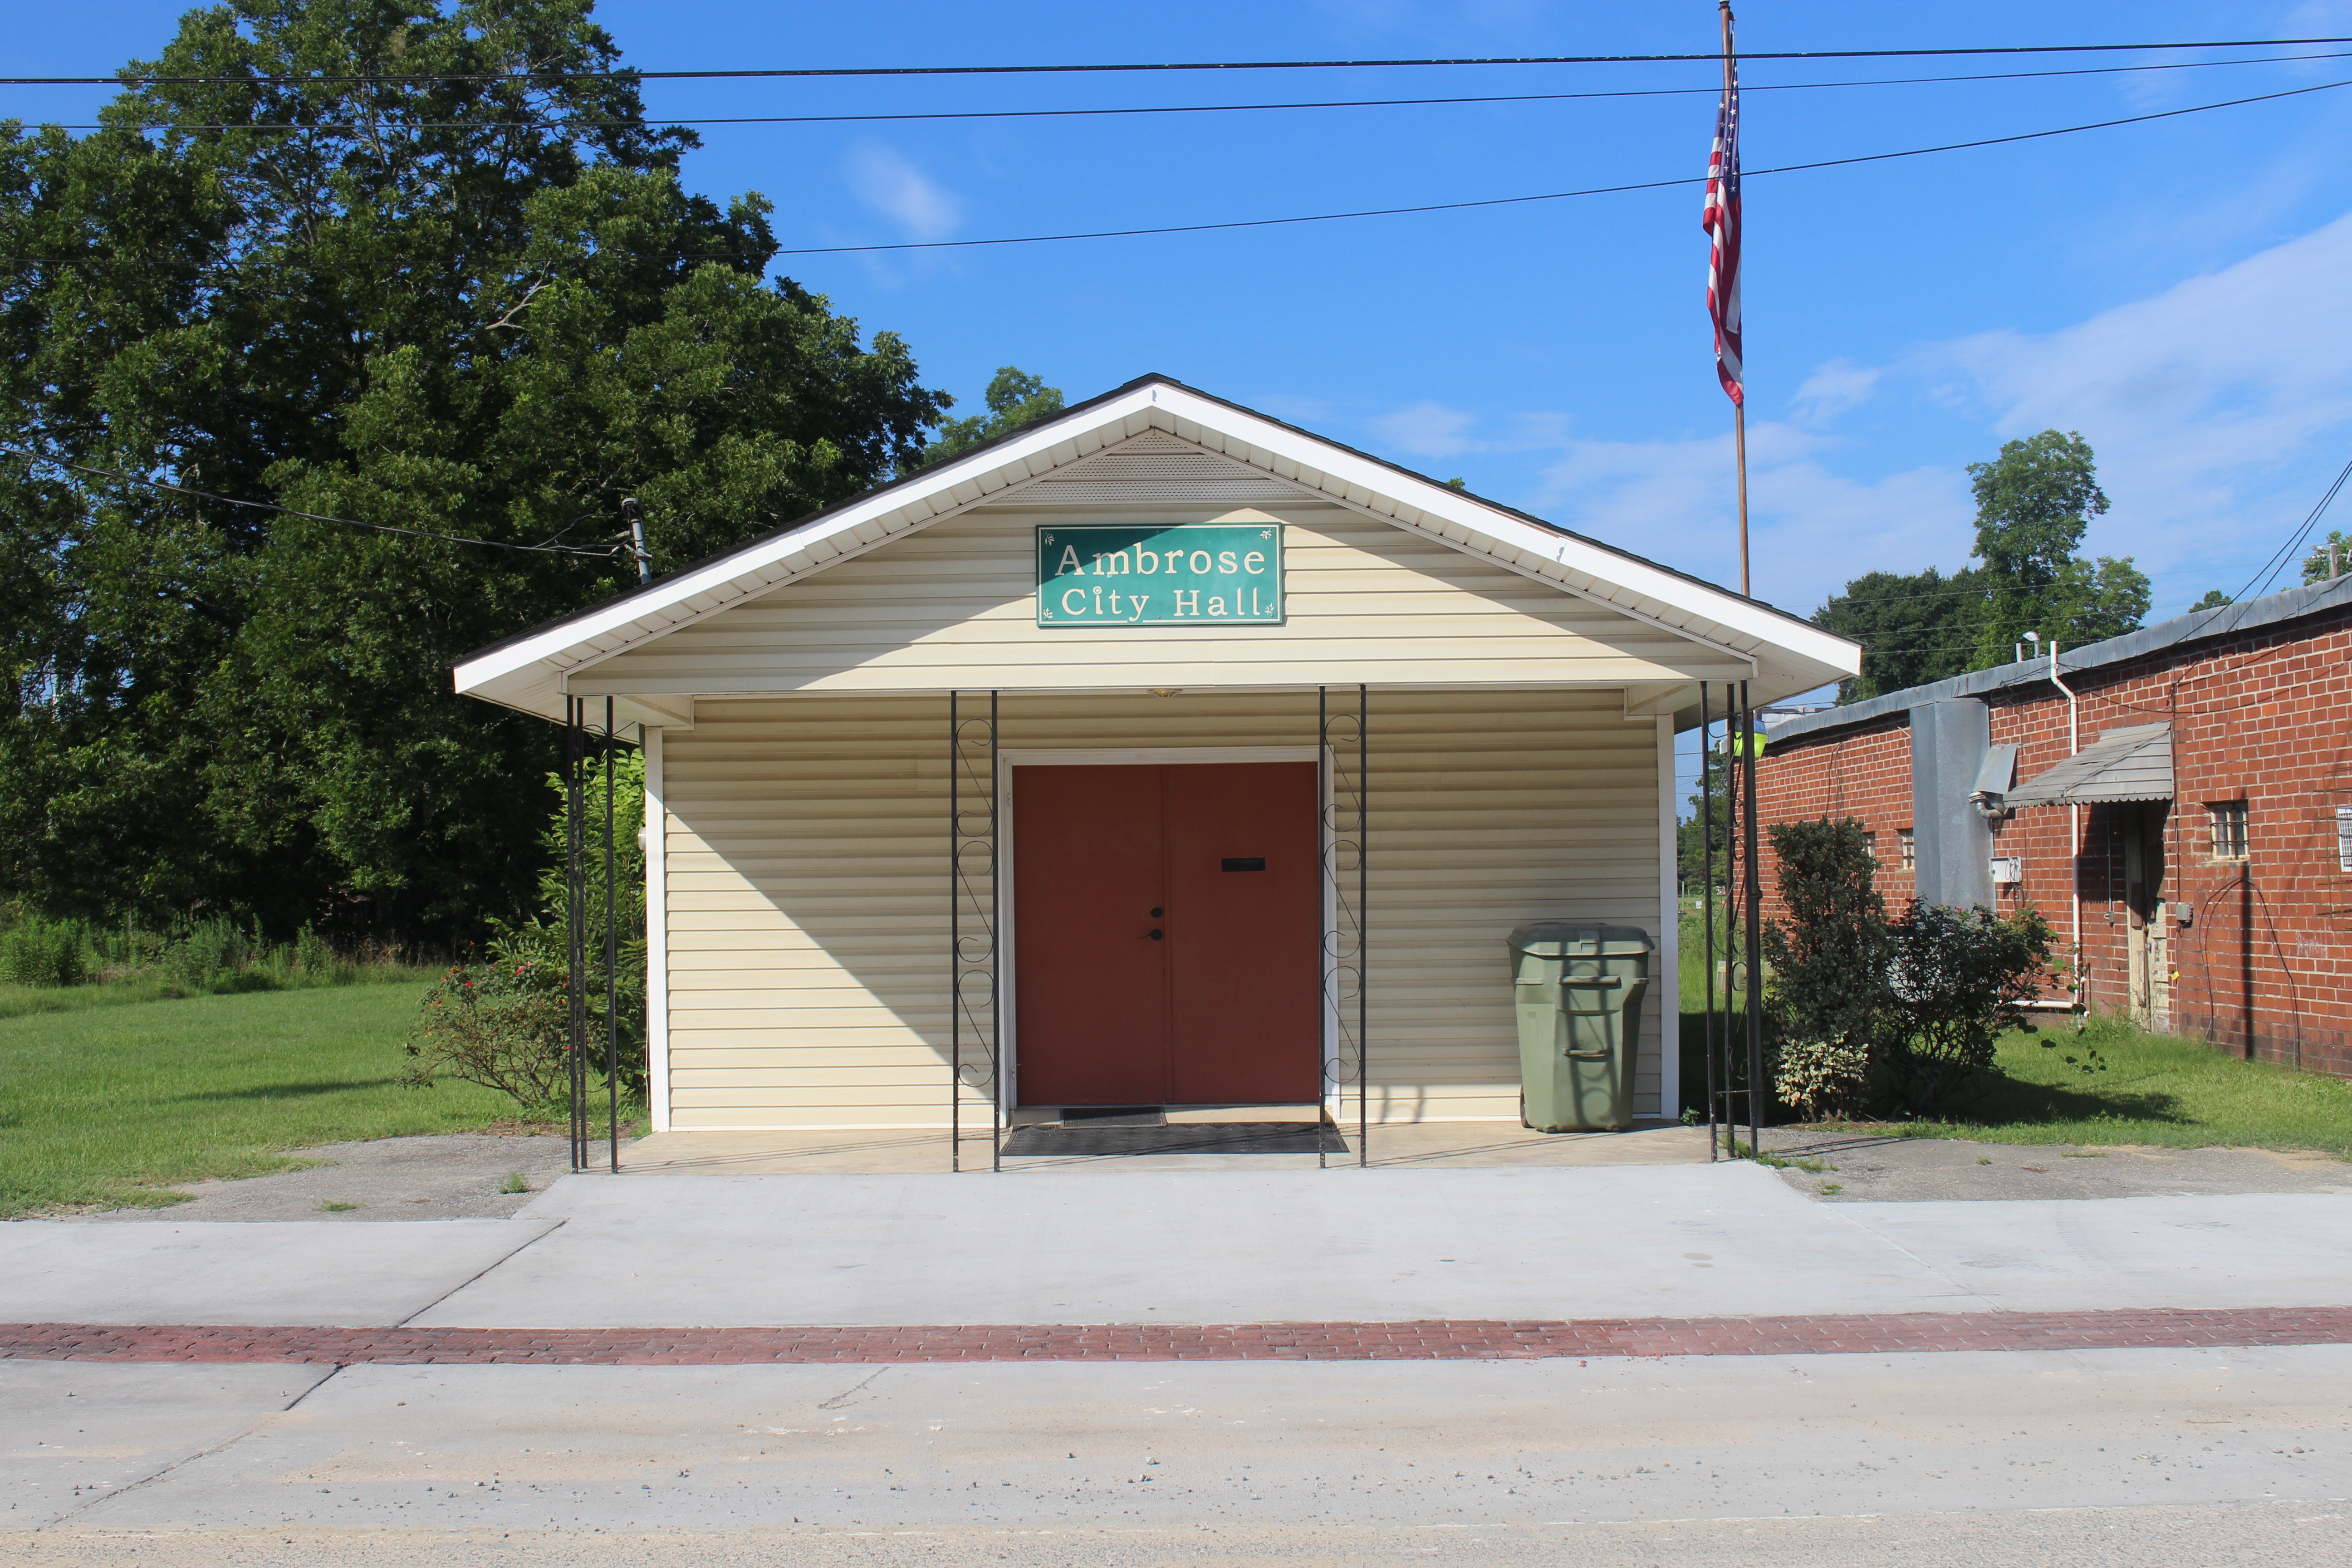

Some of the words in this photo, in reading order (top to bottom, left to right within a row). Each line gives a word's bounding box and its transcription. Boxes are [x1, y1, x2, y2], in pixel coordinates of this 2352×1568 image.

[1054, 541, 1266, 576] Ambrose
[1061, 585, 1149, 622] City
[1173, 587, 1261, 617] Hall
